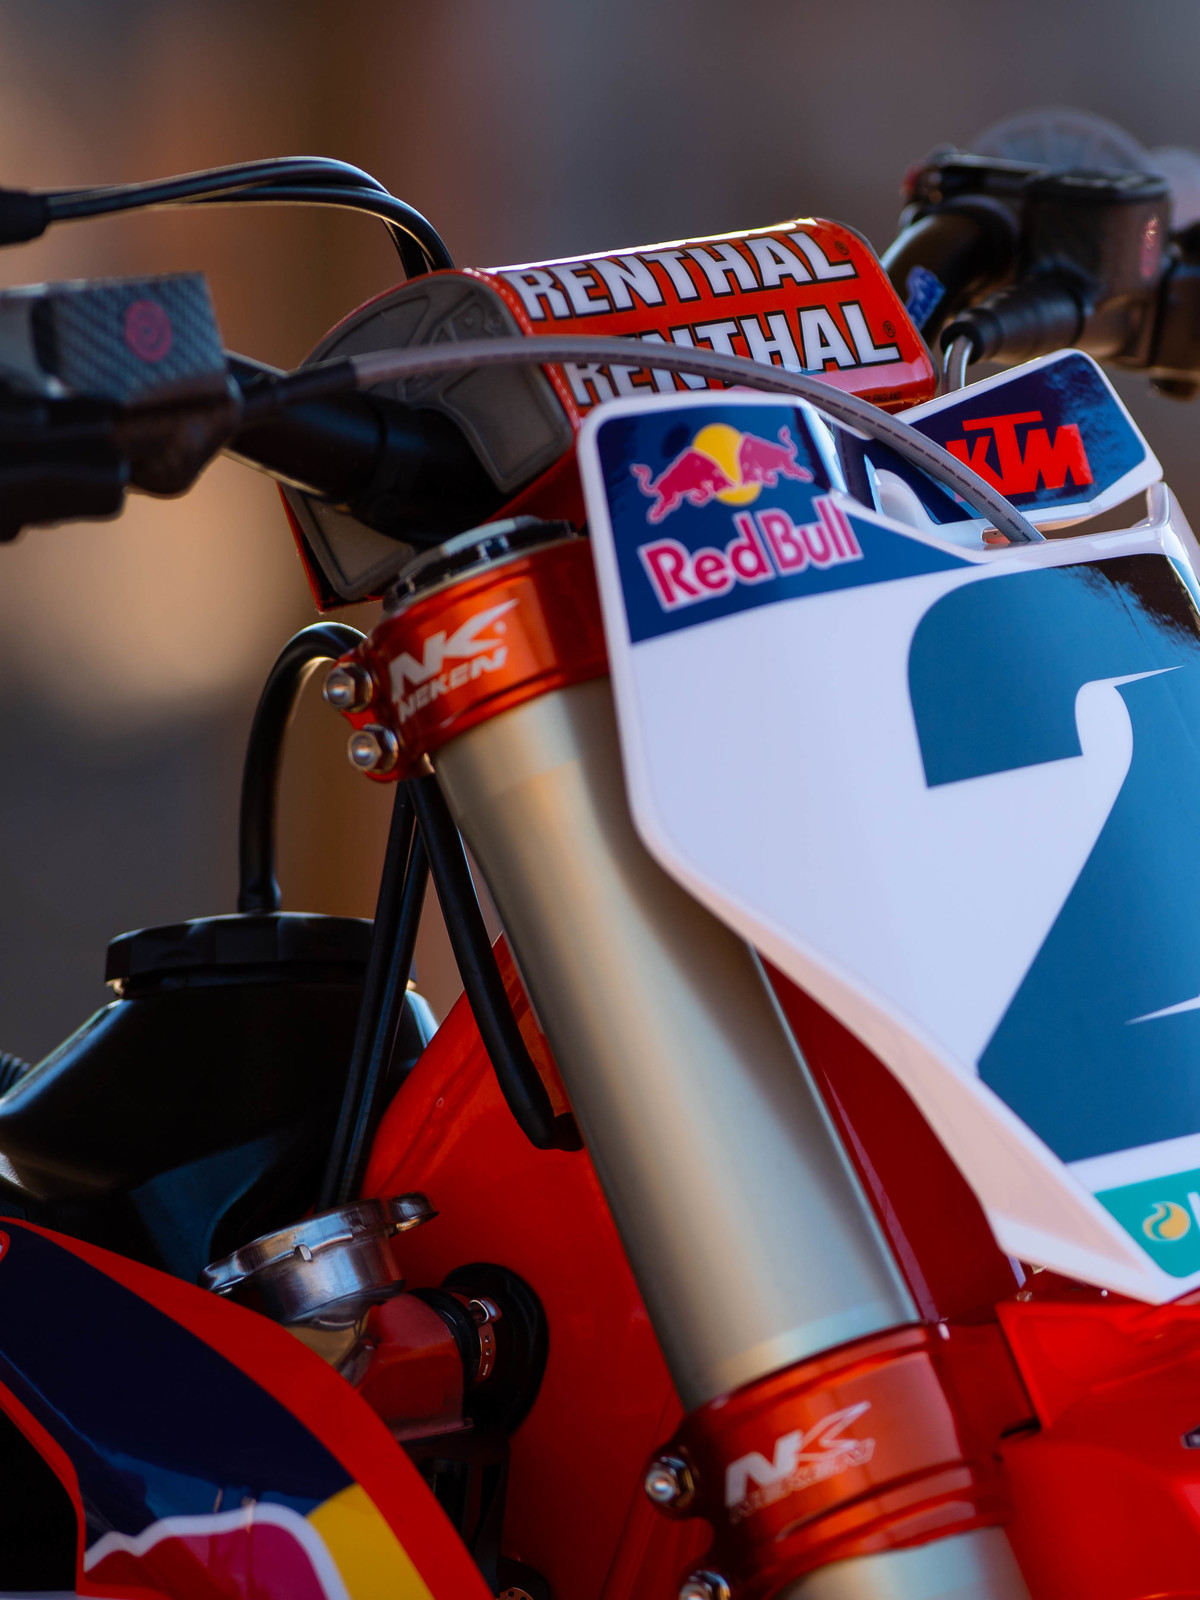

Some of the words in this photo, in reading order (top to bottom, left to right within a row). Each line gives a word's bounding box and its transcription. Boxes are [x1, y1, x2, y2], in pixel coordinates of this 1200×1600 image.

[502, 230, 857, 321] RENTHAL
[945, 410, 1095, 496] KTM
[640, 512, 774, 609] Red
[756, 496, 862, 575] Bull
[399, 646, 509, 723] NEKEN
